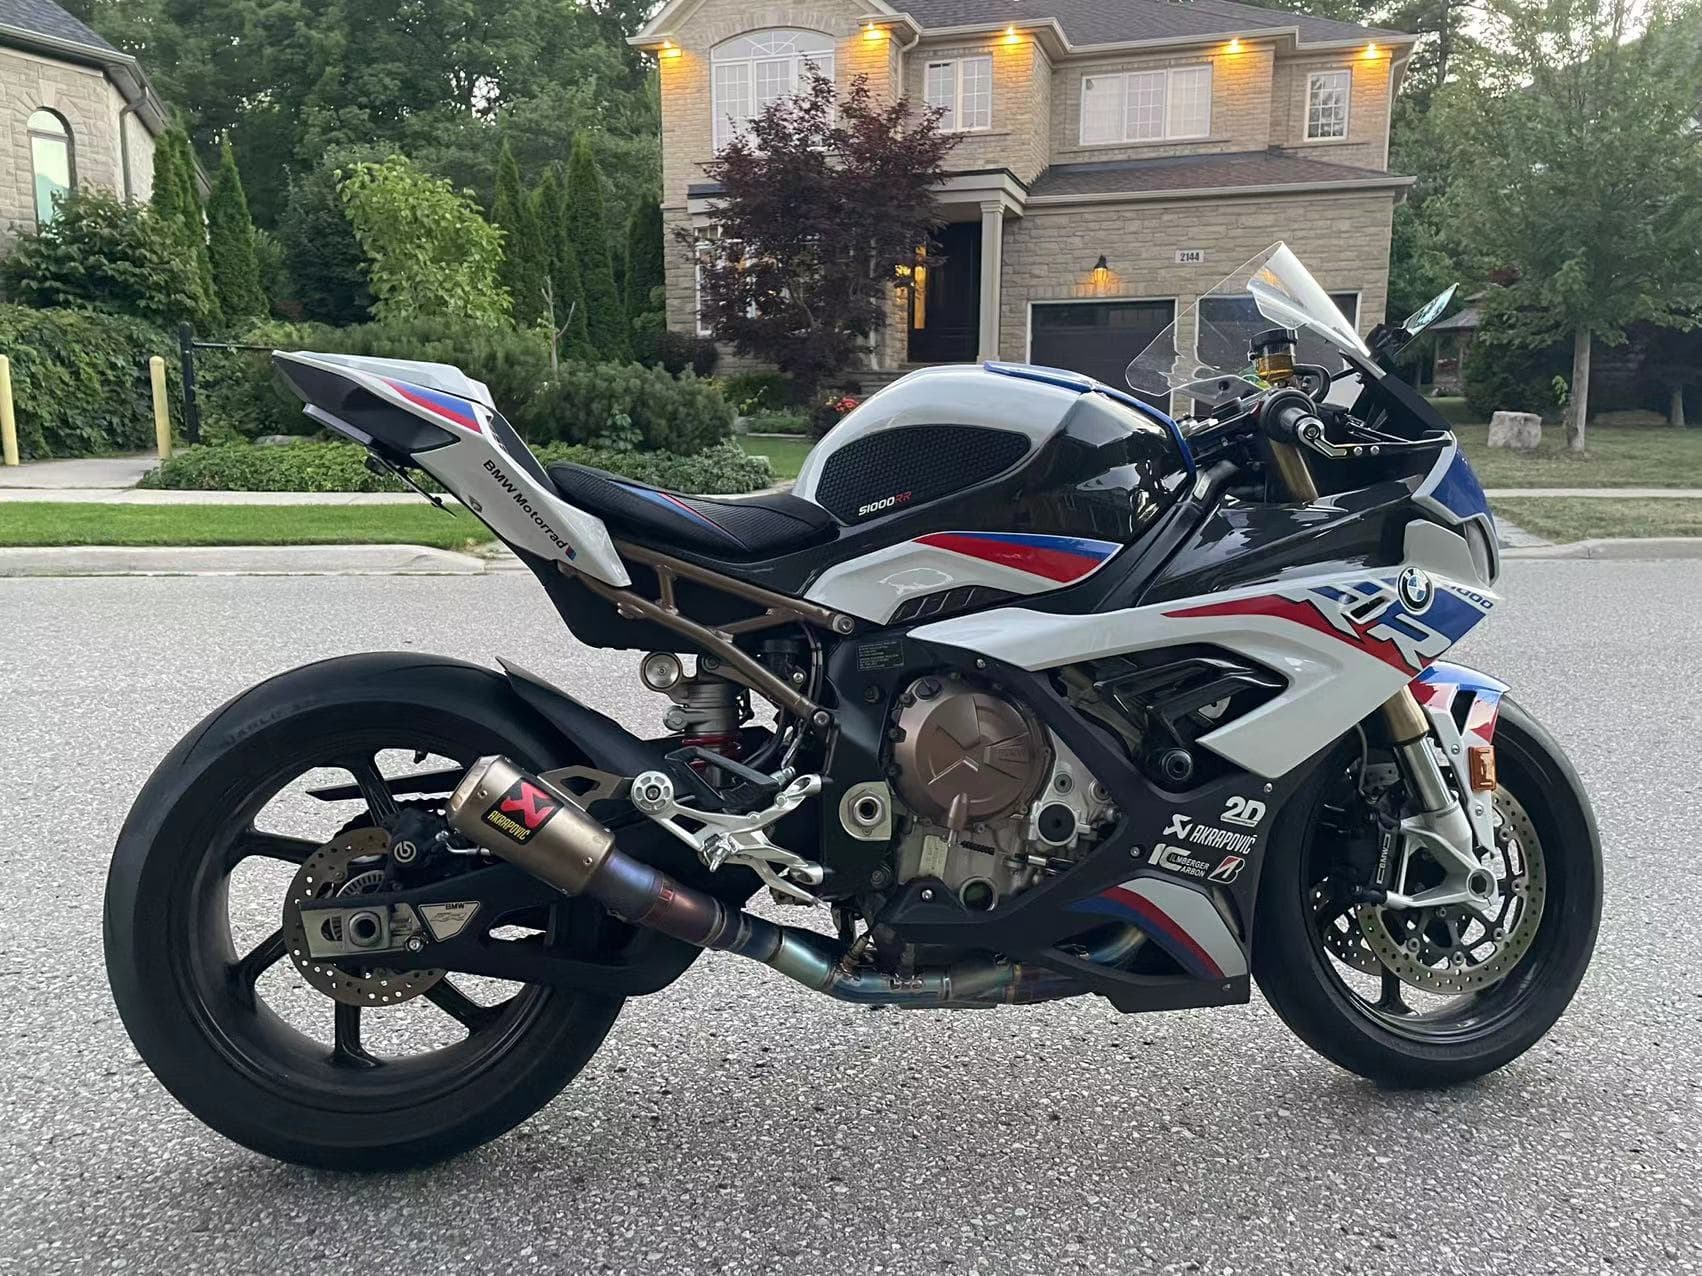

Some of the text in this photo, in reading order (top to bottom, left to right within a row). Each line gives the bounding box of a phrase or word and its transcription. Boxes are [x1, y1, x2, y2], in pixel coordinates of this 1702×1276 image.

[1180, 252, 1200, 262] 2144
[483, 460, 568, 549] BMW Motorrad
[1220, 796, 1266, 828] 2D
